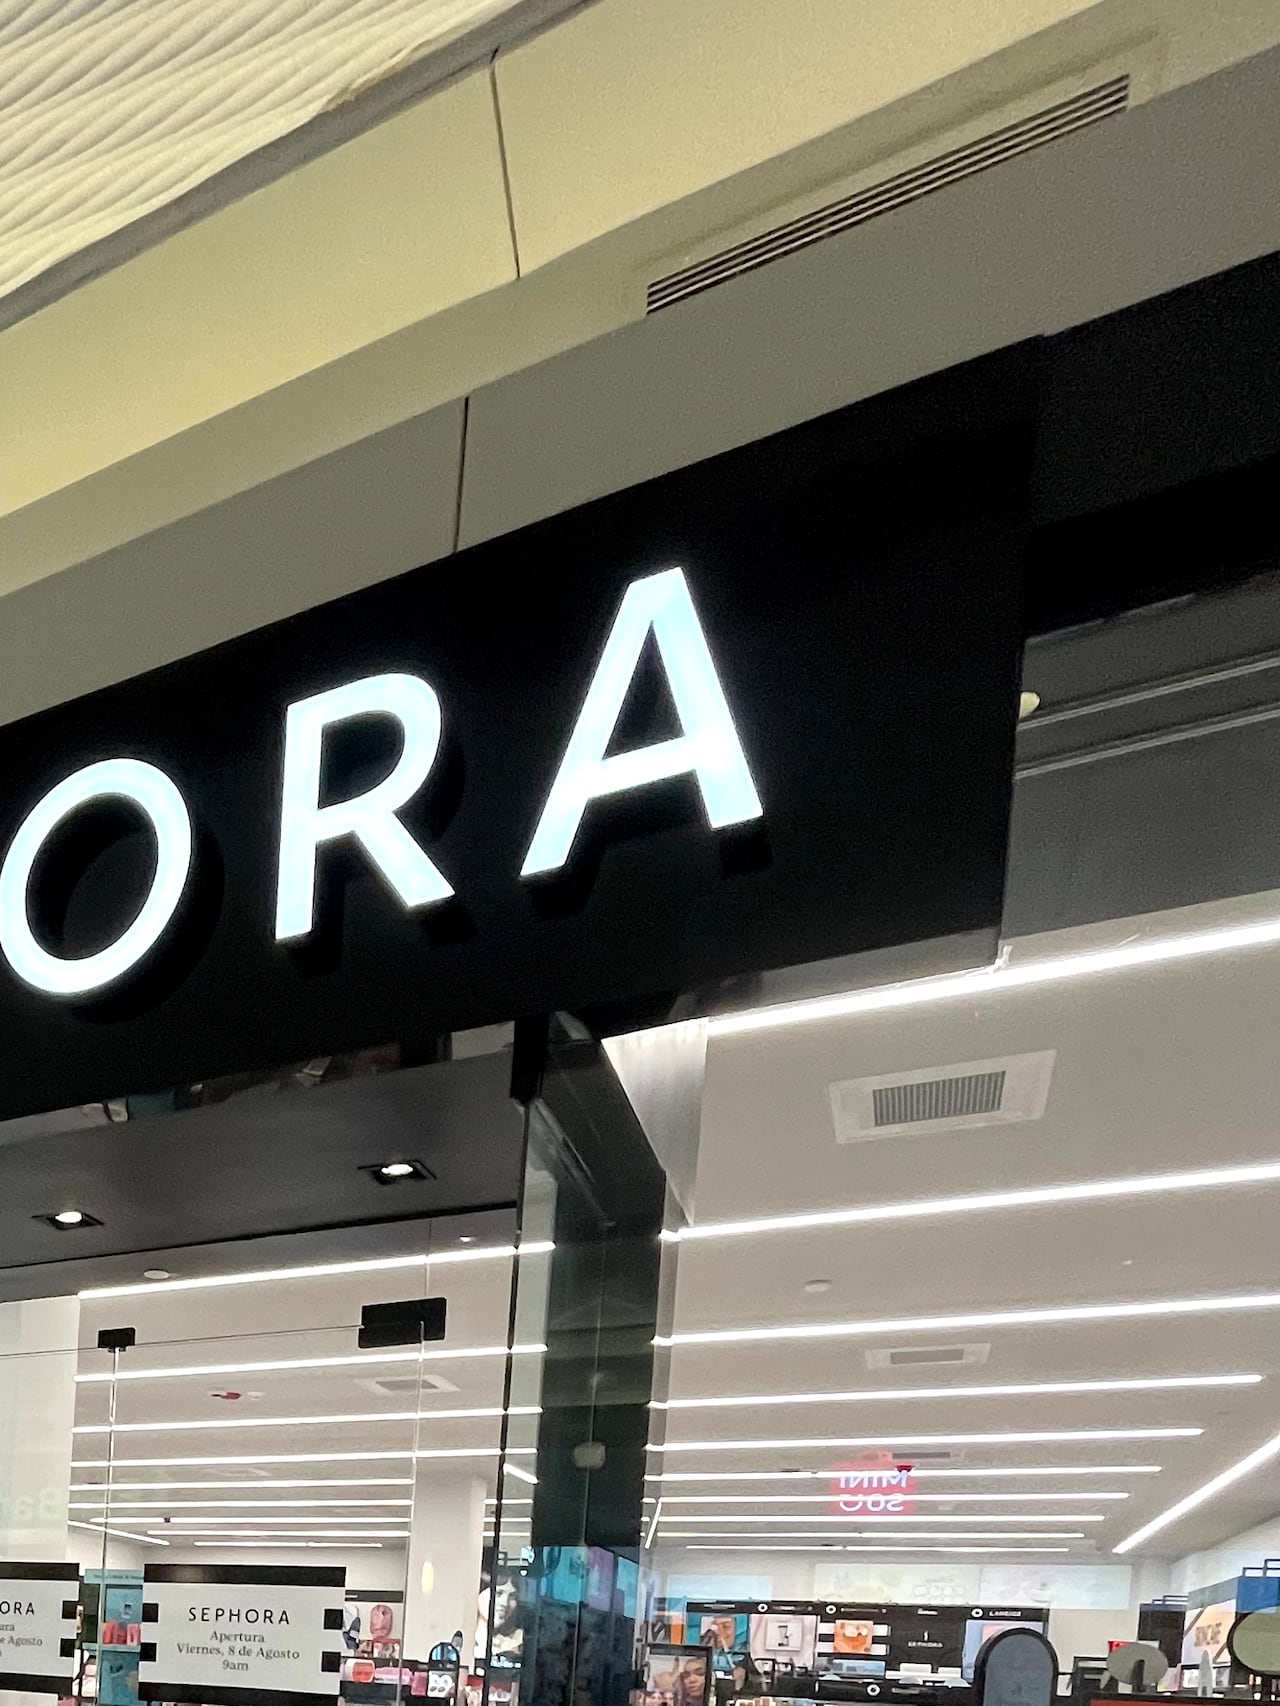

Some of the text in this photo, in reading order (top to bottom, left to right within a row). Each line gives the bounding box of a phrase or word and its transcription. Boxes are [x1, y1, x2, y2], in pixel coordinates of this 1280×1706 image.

[187, 1606, 291, 1625] SEPHORA
[7, 1636, 44, 1648] Agosto
[209, 1630, 266, 1644] Apertura
[176, 1642, 301, 1662] Viernes, 8 de Agosto
[221, 1659, 250, 1672] 9am
